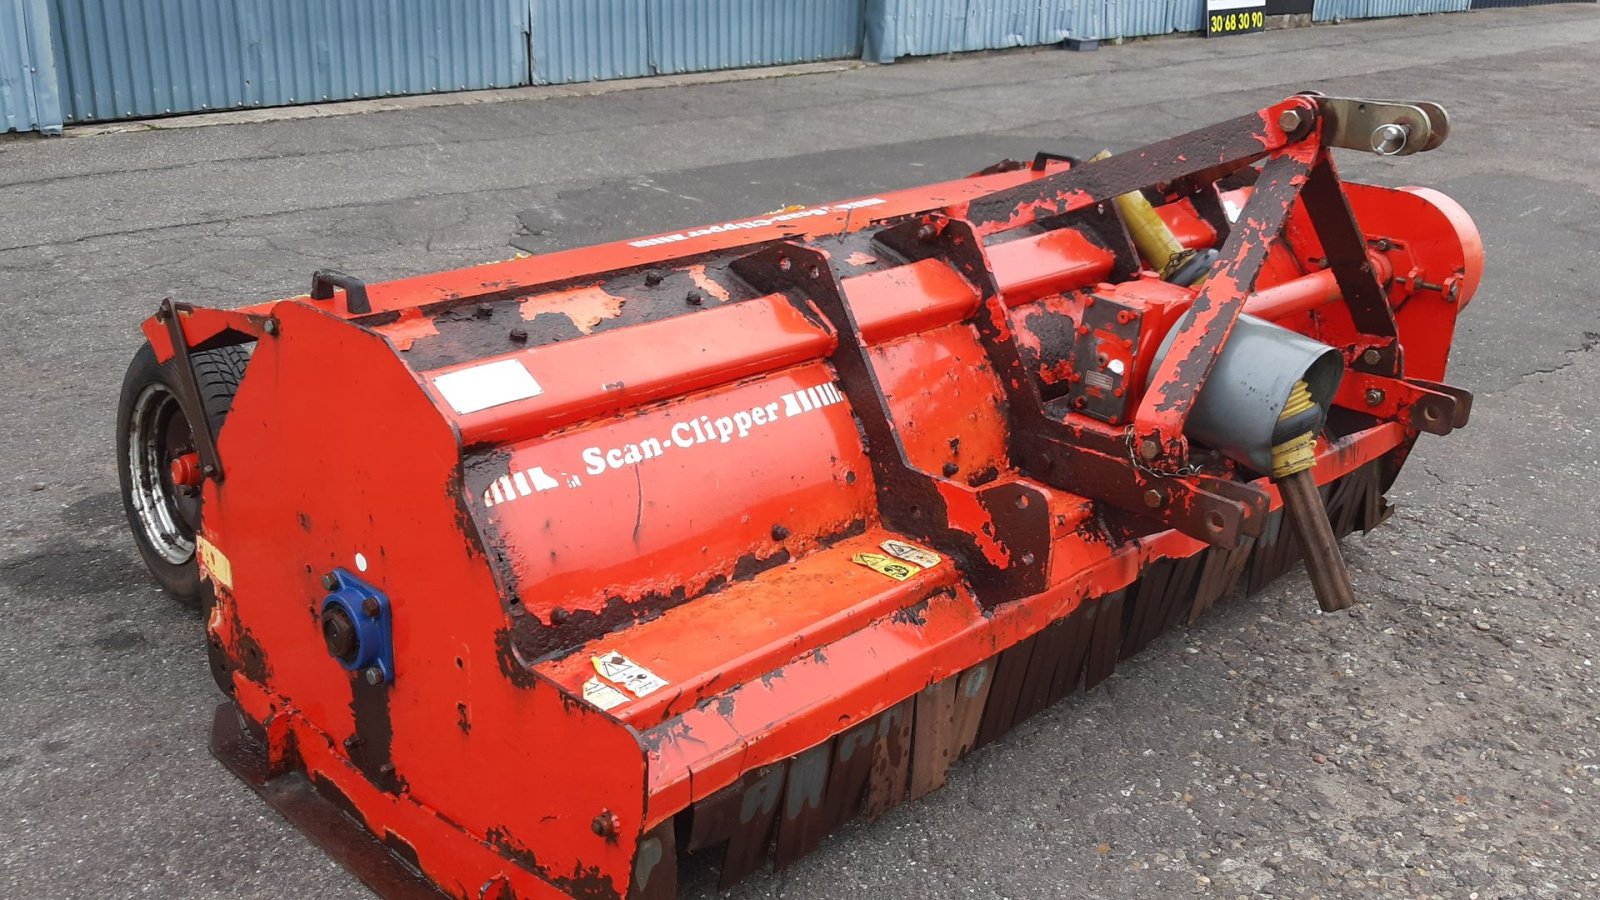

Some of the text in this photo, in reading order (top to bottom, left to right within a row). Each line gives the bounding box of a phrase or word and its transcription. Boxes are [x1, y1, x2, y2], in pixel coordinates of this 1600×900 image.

[1211, 11, 1263, 32] 30 68 30 90
[582, 402, 779, 475] Scan-Clipper
